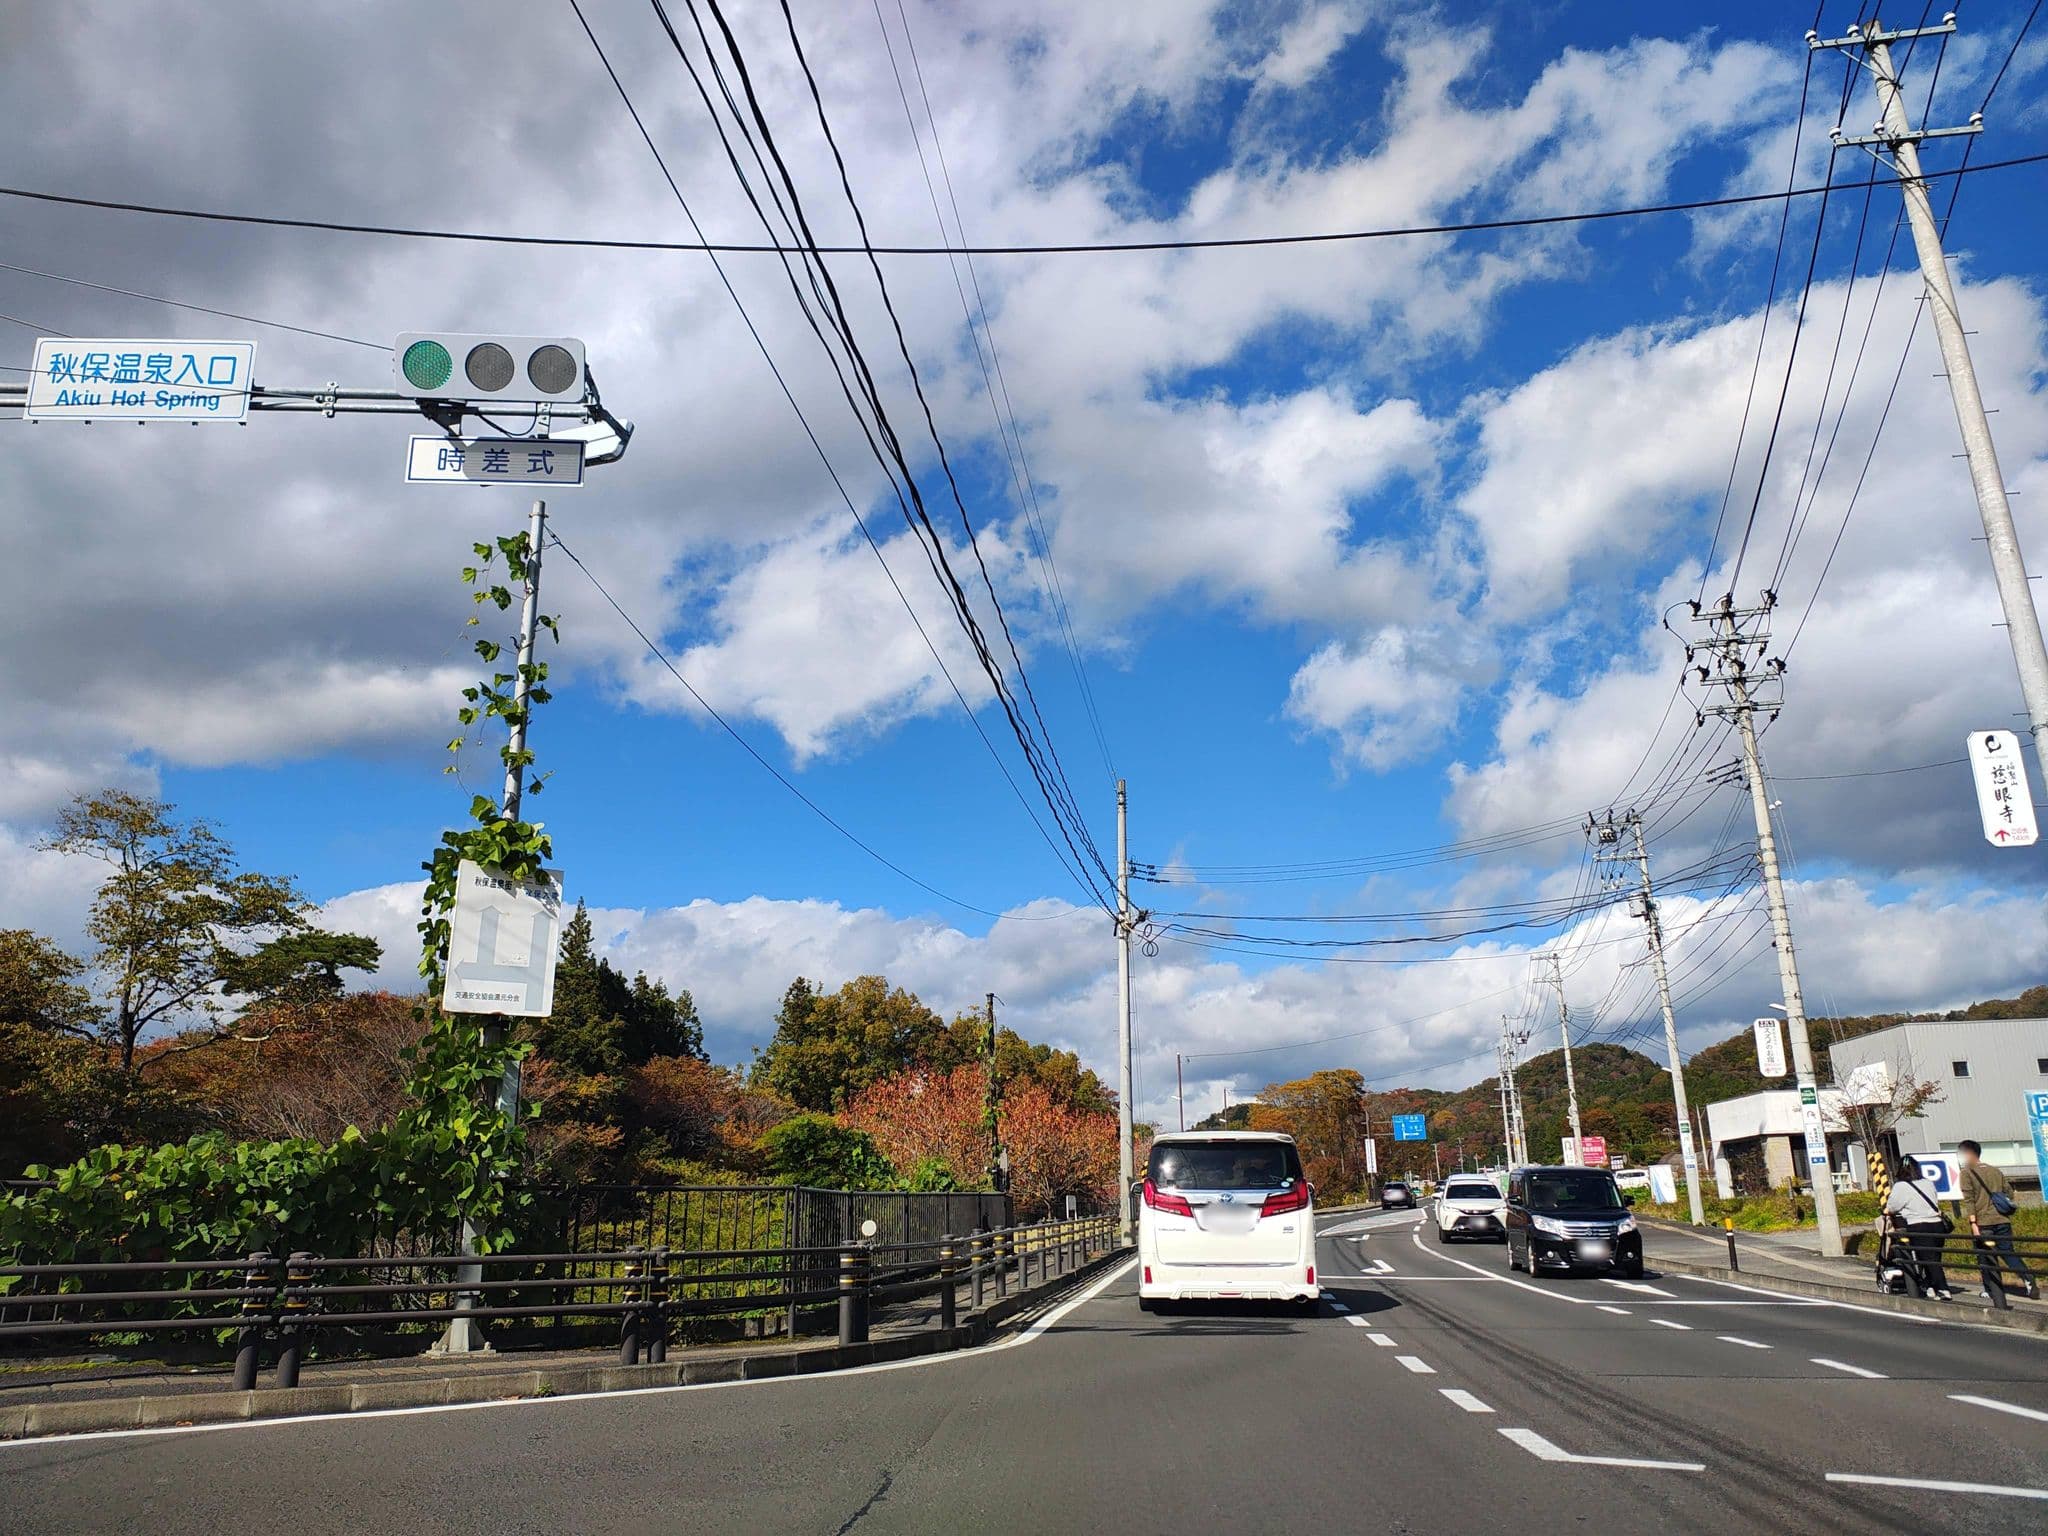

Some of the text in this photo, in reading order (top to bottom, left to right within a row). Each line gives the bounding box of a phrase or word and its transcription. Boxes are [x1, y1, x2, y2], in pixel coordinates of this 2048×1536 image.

[47, 352, 238, 385] 秋保温泉入口
[55, 389, 221, 411] Akiu Hot Spring
[437, 447, 555, 475] 時差式
[1991, 764, 2013, 824] 慈眼寺
